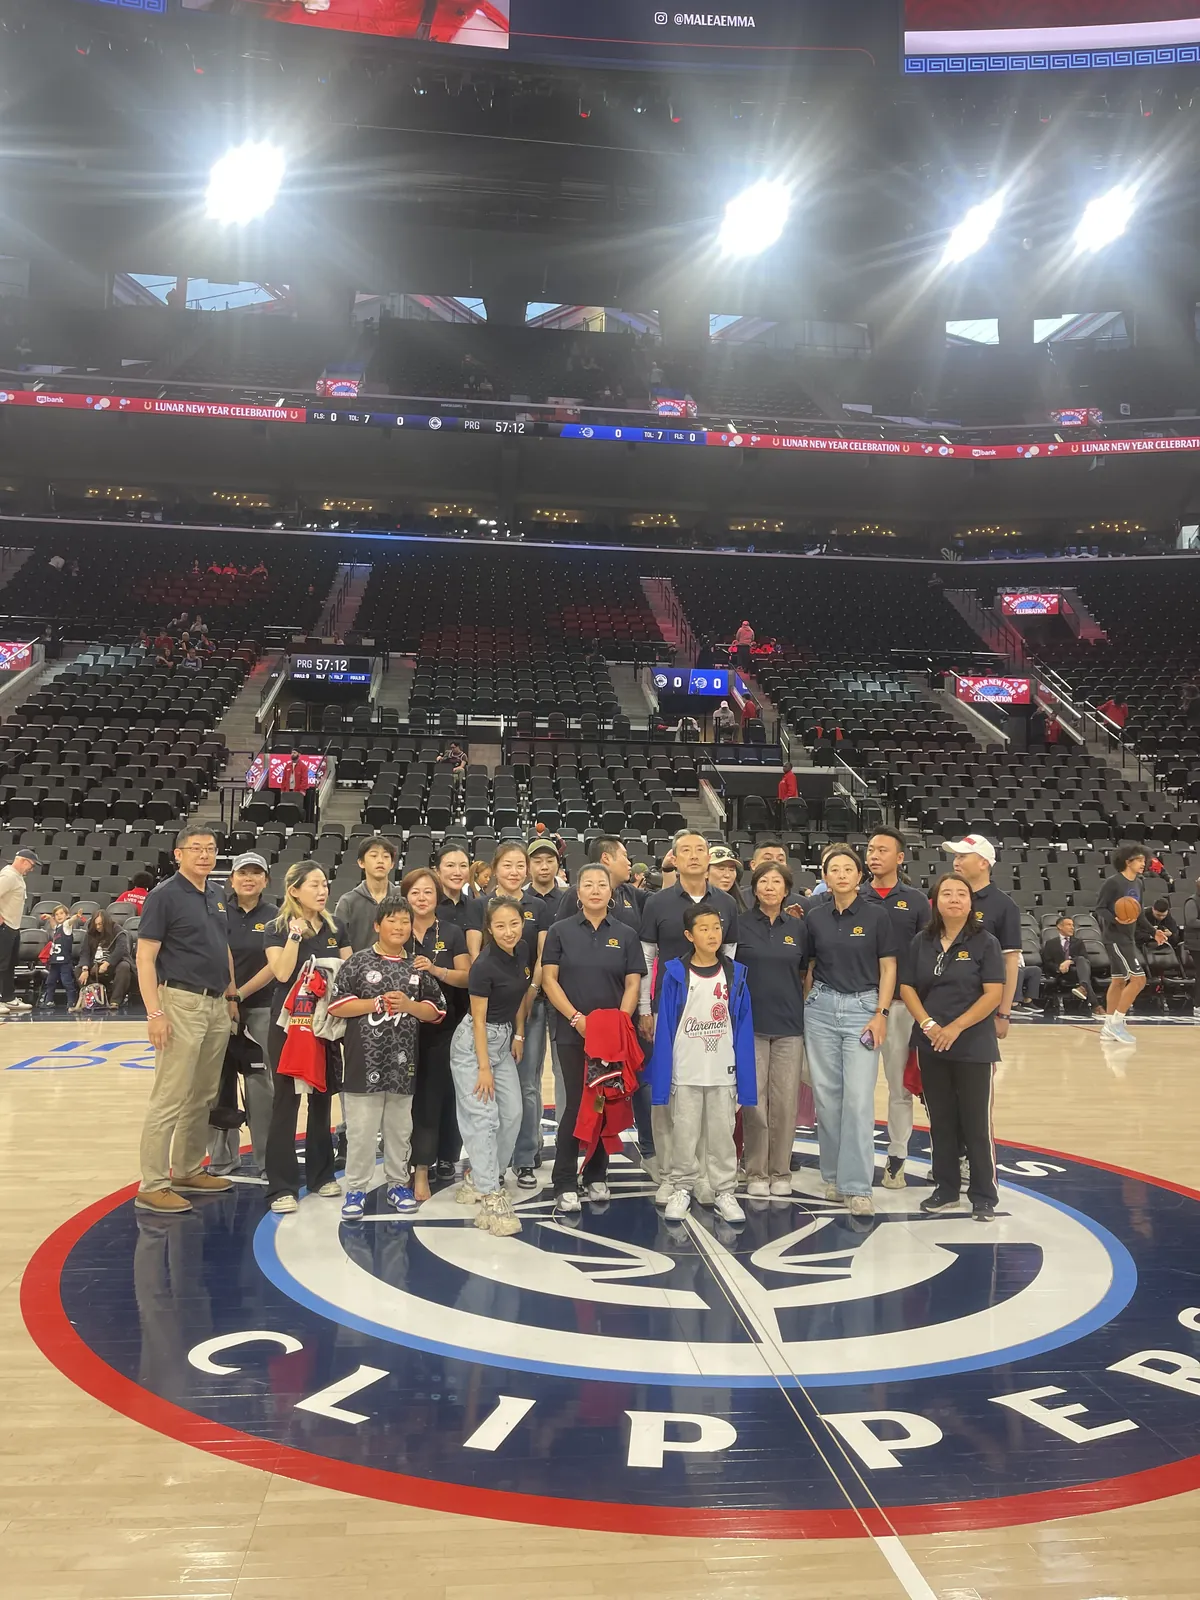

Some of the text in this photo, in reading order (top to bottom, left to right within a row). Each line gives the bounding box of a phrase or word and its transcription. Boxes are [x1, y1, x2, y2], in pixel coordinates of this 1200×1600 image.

[674, 14, 755, 27] @MALEAEMMA
[156, 402, 287, 418] LUNAR NEW YEAR CELEBRATION
[331, 412, 337, 421] 0
[364, 415, 370, 423] 7
[397, 417, 404, 426] 0
[464, 421, 480, 429] PRG
[495, 422, 525, 433] 57:12
[615, 429, 622, 438] 0
[690, 433, 695, 441] 0
[782, 438, 900, 452] LUNAR NEW YEAR CELEBRATION
[1082, 440, 1200, 452] LUNAR NEW YEAR CELEBRATI
[1010, 596, 1026, 608] LUNAR
[1038, 597, 1050, 608] YEAR
[297, 659, 348, 671] PRG 57:12
[674, 677, 721, 689] 0 0
[969, 679, 988, 695] LUNAR
[1002, 681, 1016, 696] YEAR
[187, 1306, 1200, 1470] CLIPPER
